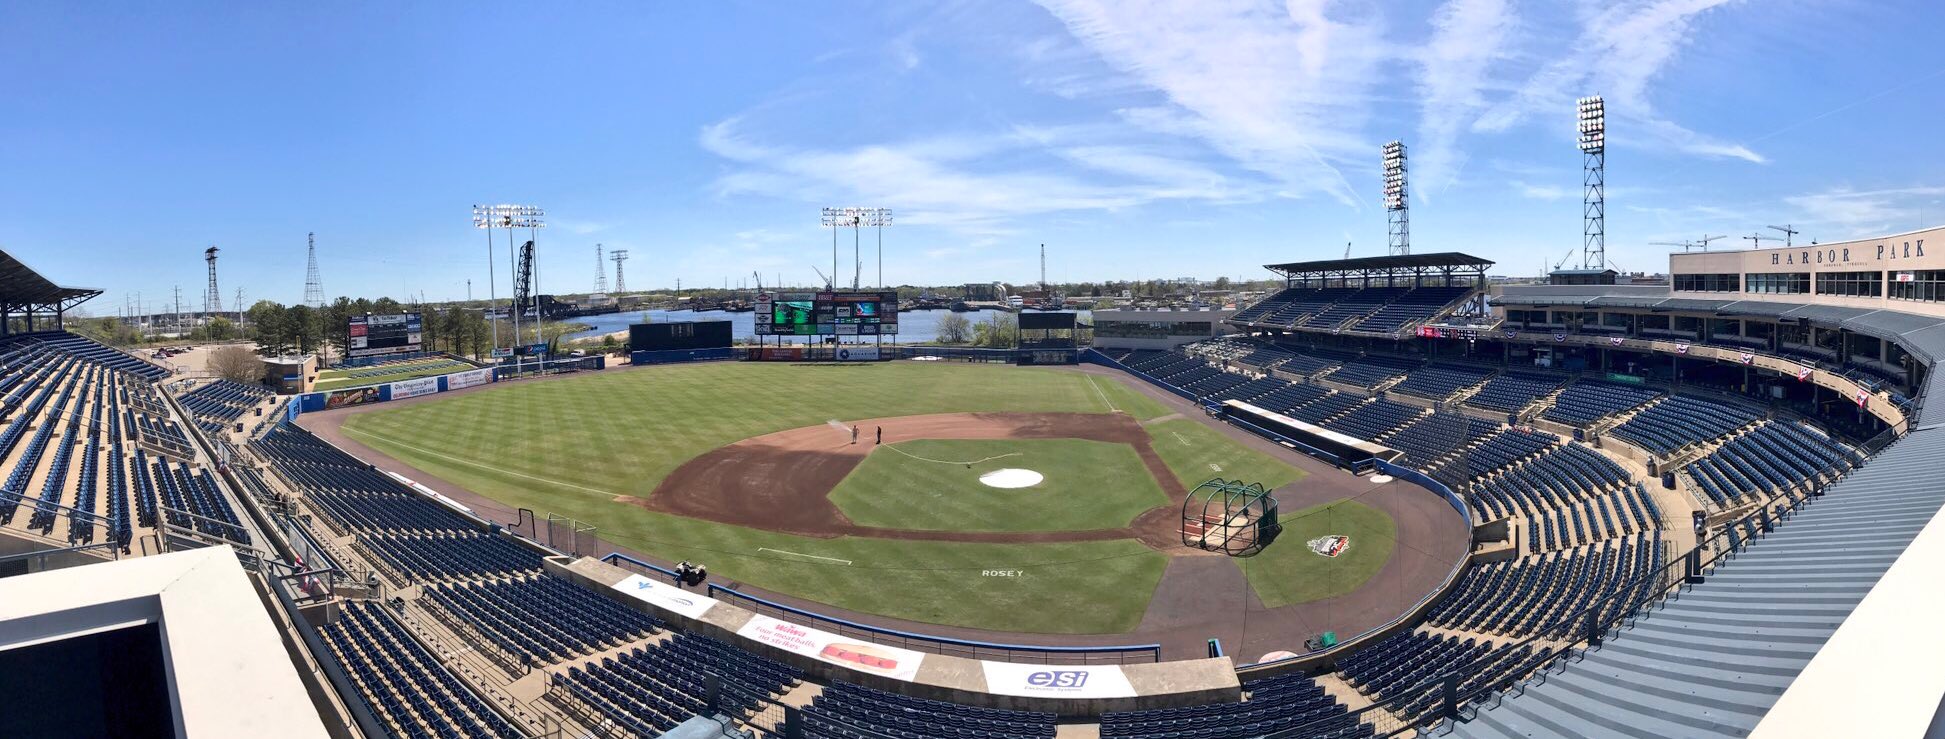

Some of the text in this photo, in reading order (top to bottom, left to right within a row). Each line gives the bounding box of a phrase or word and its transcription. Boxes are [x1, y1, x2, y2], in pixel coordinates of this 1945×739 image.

[1771, 239, 1924, 265] HARBOR PARK
[755, 626, 772, 634] Four
[770, 637, 800, 650] strikes
